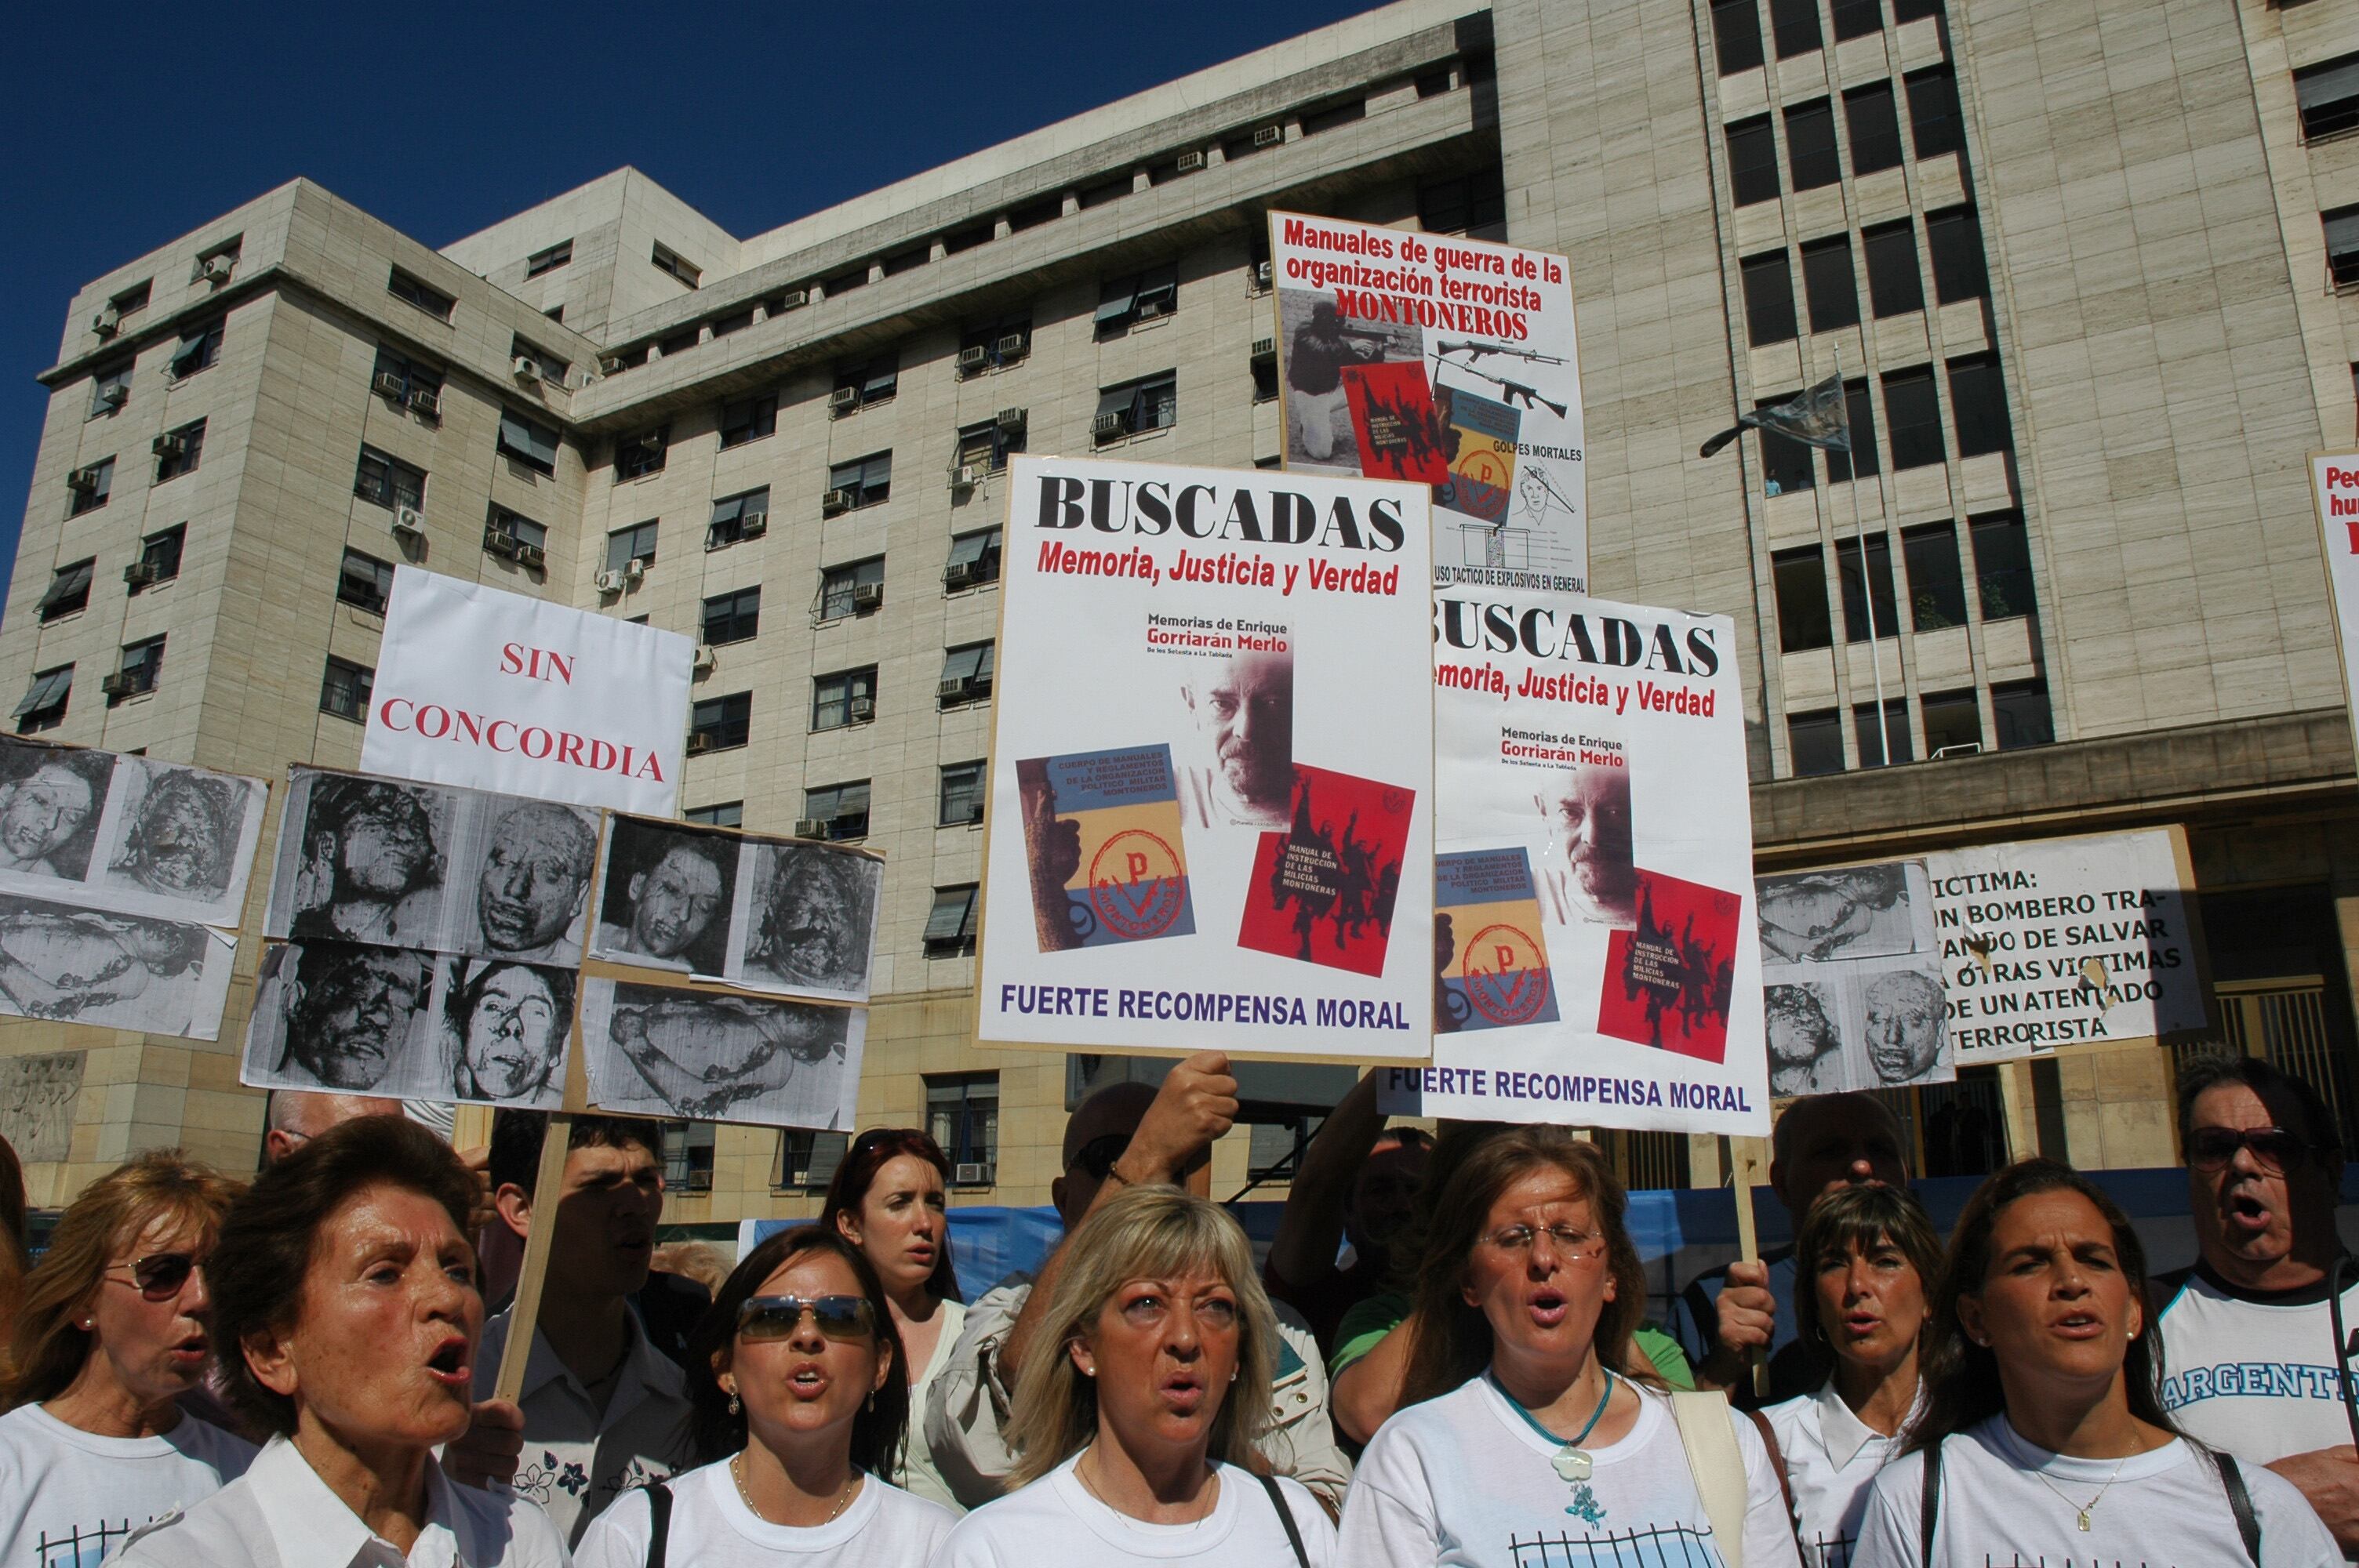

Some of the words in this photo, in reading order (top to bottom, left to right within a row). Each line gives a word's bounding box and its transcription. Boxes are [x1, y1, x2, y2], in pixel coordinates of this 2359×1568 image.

[1284, 219, 1394, 259] Manuales
[1401, 236, 1427, 263] de
[1434, 246, 1505, 275] guerra
[1511, 253, 1537, 280] de
[1543, 257, 1562, 285] la
[1286, 257, 1433, 296] organización
[1440, 273, 1542, 312] terrorista
[1334, 288, 1528, 340] MONTONEROS
[1493, 440, 1529, 456] GOLPES
[1532, 444, 1583, 461] MORTALES
[1034, 475, 1405, 552] BUSCADAS
[2331, 494, 2359, 517] hu
[1038, 541, 1161, 586] Memoria,
[1169, 549, 1274, 586] Justicia
[1282, 561, 1299, 596] y
[1307, 558, 1400, 596] Verdad
[1434, 565, 1450, 581] USO
[1452, 567, 1483, 584] TACTICO
[1485, 570, 1495, 585] DE
[1497, 571, 1540, 589] EXPLOSIVOS
[1542, 575, 1551, 590] EN
[1554, 575, 1585, 593] GENERAL
[1148, 613, 1213, 628] Memorias
[1217, 619, 1233, 630] de
[1237, 619, 1287, 636] Enrique
[1147, 628, 1232, 648] Gorriarán
[1238, 634, 1287, 653] Merlo
[500, 642, 576, 686] SIN
[1518, 668, 1608, 706] Justicia
[1616, 686, 1629, 716] y
[1637, 681, 1714, 717] Verdad
[380, 698, 664, 783] CONCORDIA
[1502, 726, 1558, 743] Memorias
[1561, 734, 1576, 745] de
[1579, 735, 1622, 751] Enrique
[1059, 759, 1096, 769] CUERPO
[1114, 752, 1163, 763] MANUALES
[1501, 740, 1576, 762] Gorriarán
[1580, 749, 1623, 767] Merlo
[1095, 768, 1165, 782] ORGANIZACION
[1096, 760, 1164, 773] REGLAMENTOS
[1081, 780, 1124, 791] POLITICO
[1129, 775, 1166, 785] MILITAR
[1103, 784, 1168, 796] MONTONEROS
[1287, 853, 1337, 869] INSTRUCCION
[1289, 844, 1318, 857] MANUAL
[1321, 851, 1332, 859] DE
[1435, 858, 1463, 867] UERPO
[1478, 854, 1521, 863] MANUALES
[1126, 852, 1148, 887] P
[1284, 869, 1318, 883] MILICIAS
[1285, 861, 1295, 869] DE
[1298, 864, 1313, 873] LAS
[1463, 862, 1522, 873] REGLAMENTOS
[1463, 869, 1524, 880] ORGANIZACION
[1282, 878, 1336, 895] MONTONERAS
[1451, 879, 1488, 888] POLITICO
[1492, 876, 1525, 884] MILITAR
[1470, 883, 1527, 893] MONTONEROS
[1931, 871, 2037, 898] ICTIMA:
[1934, 908, 1959, 928] N
[1967, 895, 2095, 924] BOMBERO
[2102, 889, 2165, 911] TRA-
[1636, 941, 1662, 953] MANUAL
[1938, 931, 2016, 959] ANDO
[2023, 928, 2058, 949] DE
[2065, 919, 2168, 946] SALVAR
[1494, 945, 1514, 977] P
[1635, 949, 1679, 964] INSTRUCCION
[1645, 959, 1658, 967] LAS
[1633, 964, 1663, 977] MILICIAS
[1633, 972, 1680, 989] MONTONERAS
[1001, 984, 1109, 1017] FUERTE
[1118, 989, 1307, 1026] RECOMPENSA
[1316, 998, 1410, 1030] MORAL
[1980, 993, 2019, 1015] UN
[2024, 981, 2163, 1011] ATENTADO
[1390, 1067, 1487, 1096] FUERTE
[1496, 1071, 1662, 1107] RECOMPENSA
[1670, 1082, 1751, 1112] MORAL
